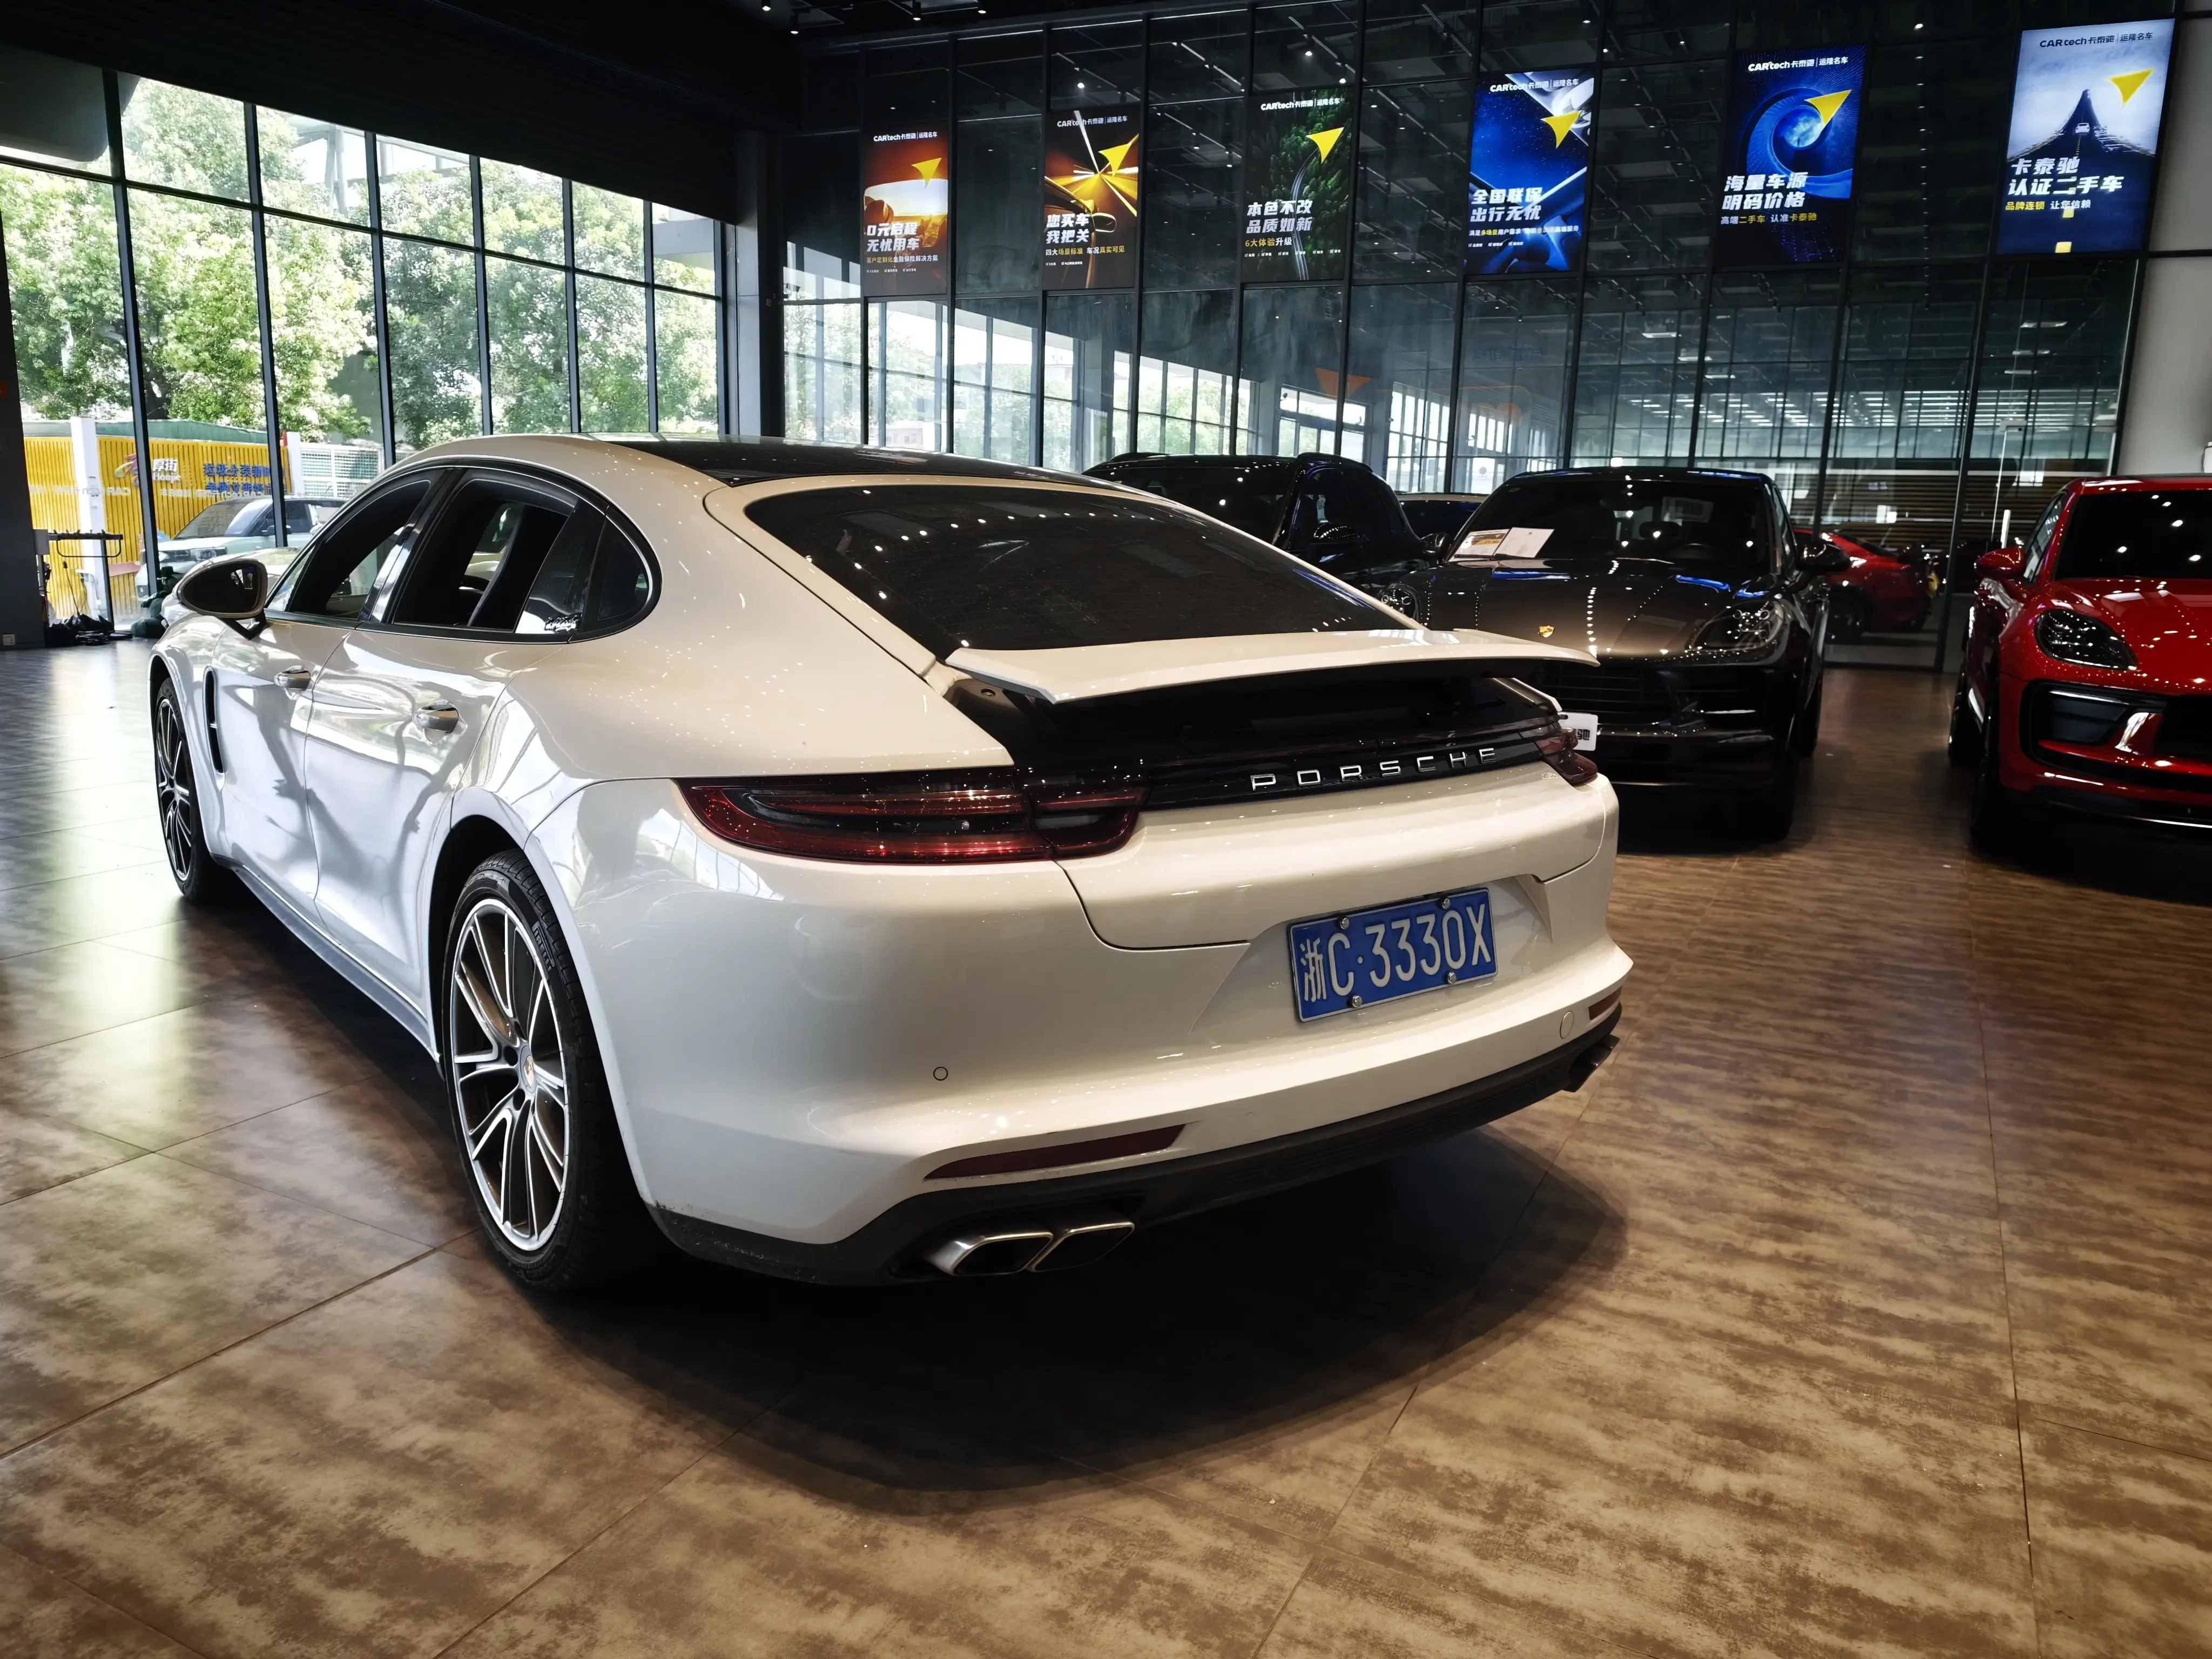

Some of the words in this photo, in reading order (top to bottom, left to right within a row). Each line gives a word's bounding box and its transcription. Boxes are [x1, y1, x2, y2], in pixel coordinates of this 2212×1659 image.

[2088, 35, 2114, 44] 卡泰驰
[2120, 32, 2153, 42] 运隆名车
[2011, 156, 2080, 175] 卡泰驰
[1724, 172, 1808, 192] 海量车源
[2007, 176, 2124, 195] 认证二手车
[1471, 187, 1543, 204] 全国联保
[1722, 191, 1805, 210] 明码价格
[1246, 199, 1313, 217] 本色不改
[2005, 201, 2045, 211] 品牌连锁
[2050, 199, 2091, 210] 让您信赖
[1046, 213, 1090, 227] 您买车
[1470, 205, 1541, 222] 出行无忧
[1721, 215, 1765, 225] 高端二手车
[1770, 213, 1817, 223] 认准卡泰驰
[866, 222, 918, 237] 0元启程
[1246, 217, 1313, 234] 品质如新
[1046, 229, 1089, 244] 我把关
[1245, 237, 1292, 247] 6大体验升级
[866, 238, 920, 252] 无忧用车
[1087, 246, 1125, 254] 车况真实可见
[153, 458, 178, 472] 厚街
[153, 472, 181, 484] Houjie
[1251, 747, 1496, 791] PORSCHE
[531, 920, 555, 972] PIRELLI
